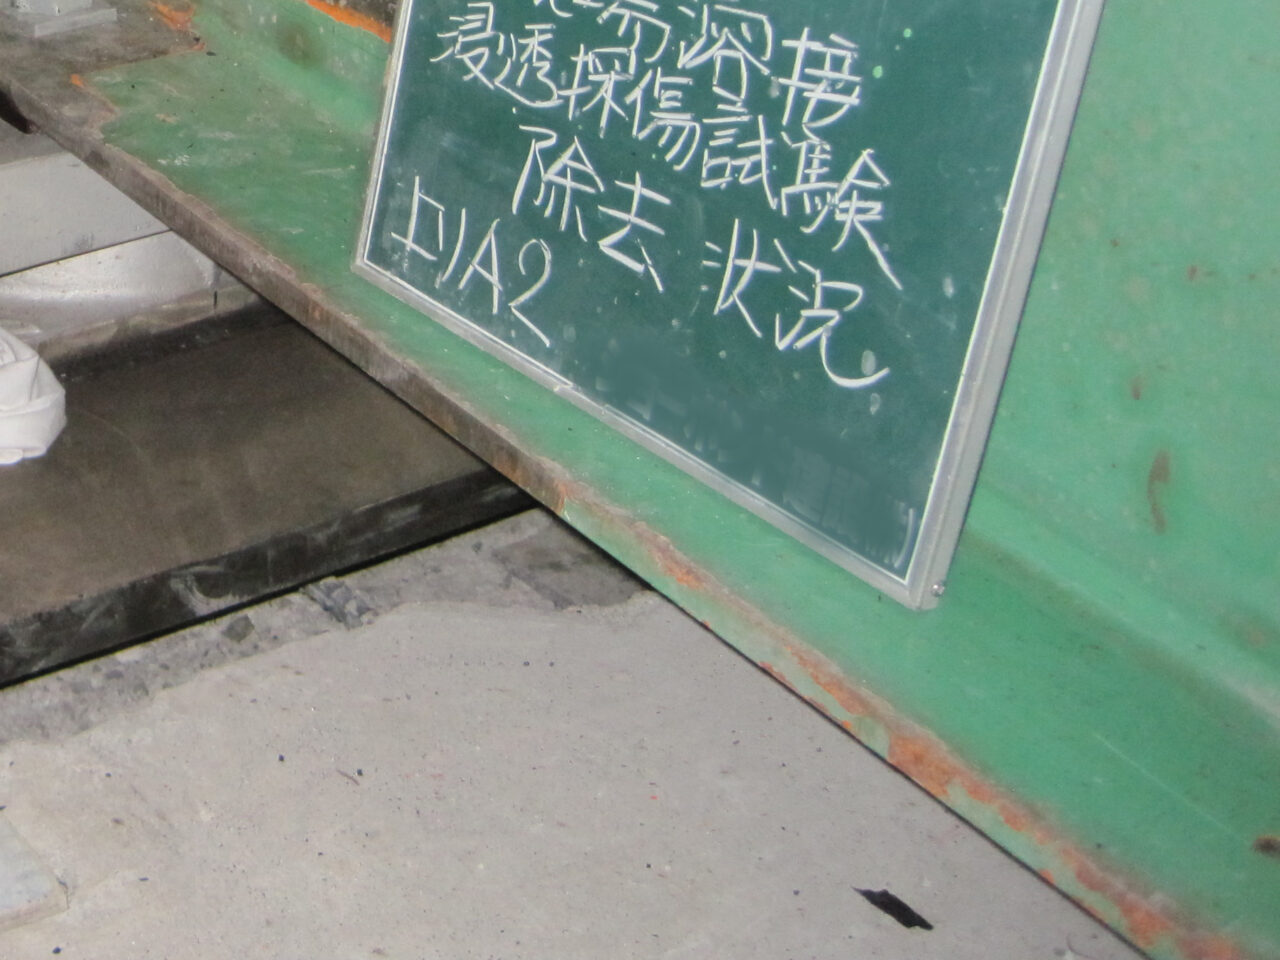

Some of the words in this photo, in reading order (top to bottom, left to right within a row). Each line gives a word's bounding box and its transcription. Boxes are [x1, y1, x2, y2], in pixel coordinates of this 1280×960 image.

[429, 2, 902, 291] 浸透探傷試験
